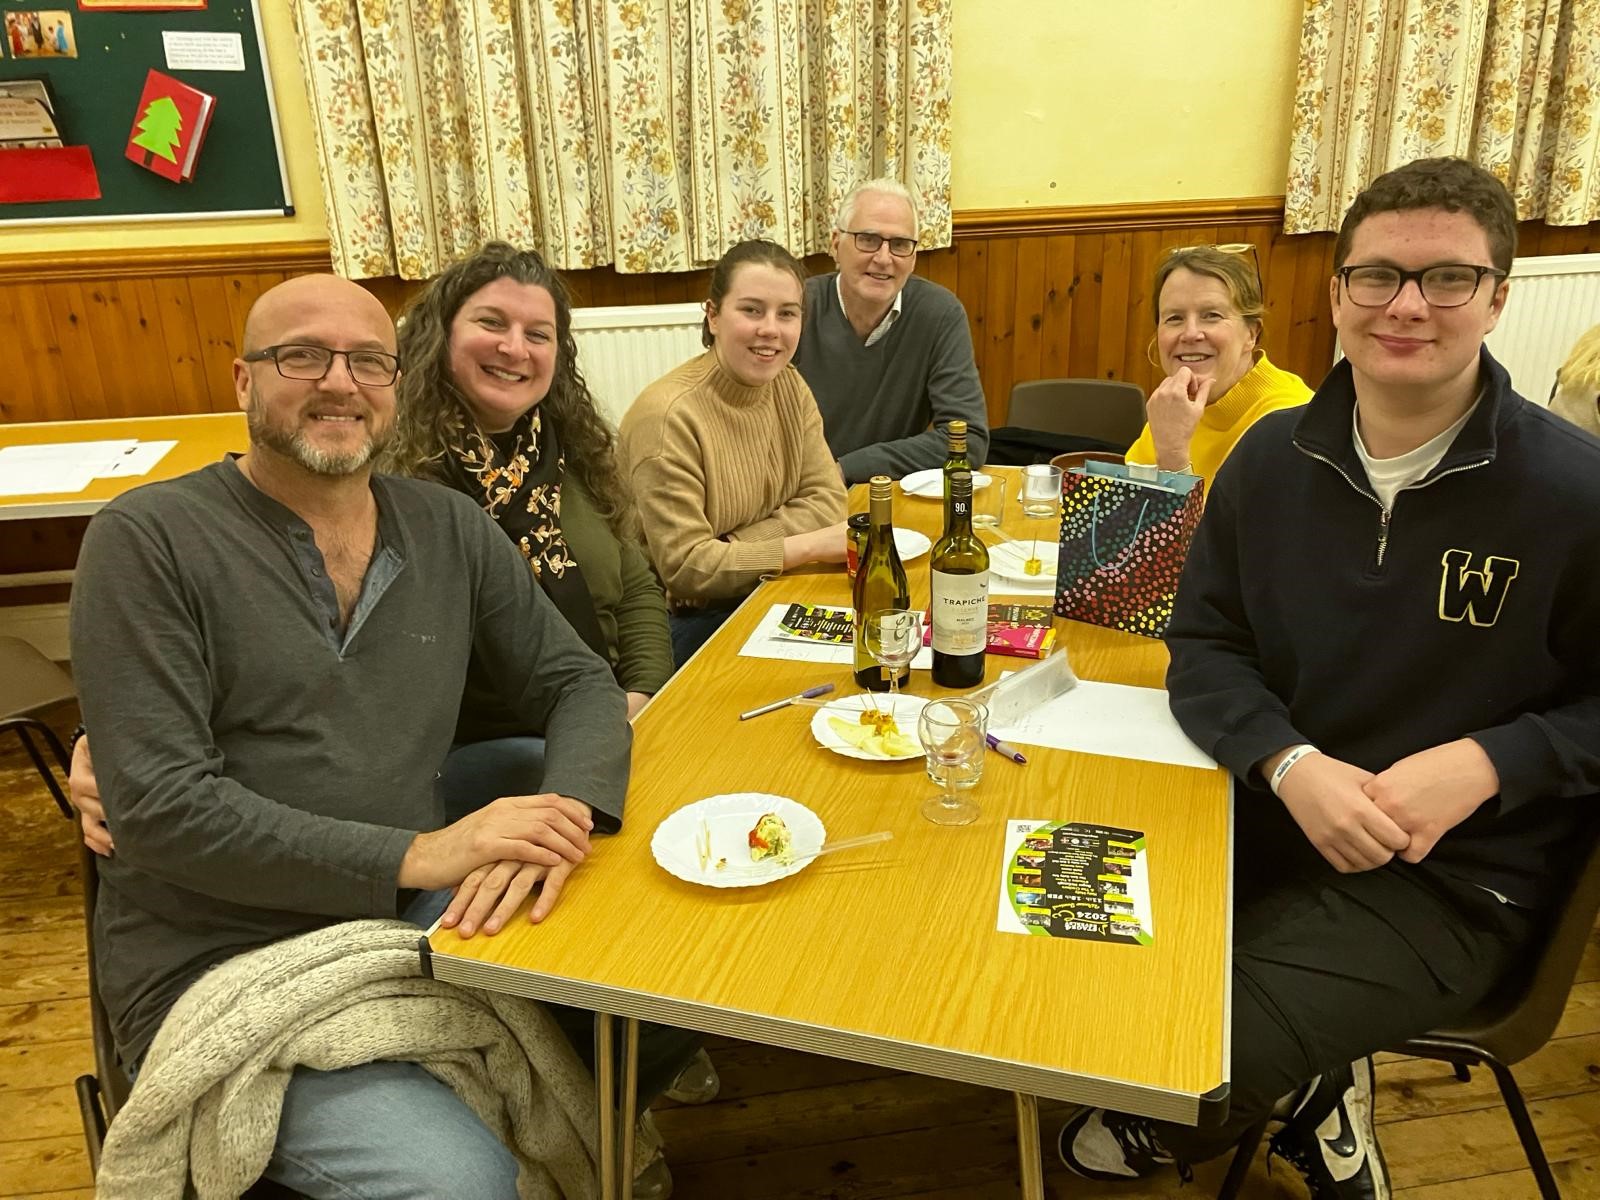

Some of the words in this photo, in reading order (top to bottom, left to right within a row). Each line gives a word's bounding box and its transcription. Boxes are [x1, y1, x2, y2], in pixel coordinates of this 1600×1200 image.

[955, 502, 966, 512] 90
[1439, 548, 1519, 627] W
[943, 595, 986, 606] TRAPICHE
[1076, 911, 1108, 921] 2024
